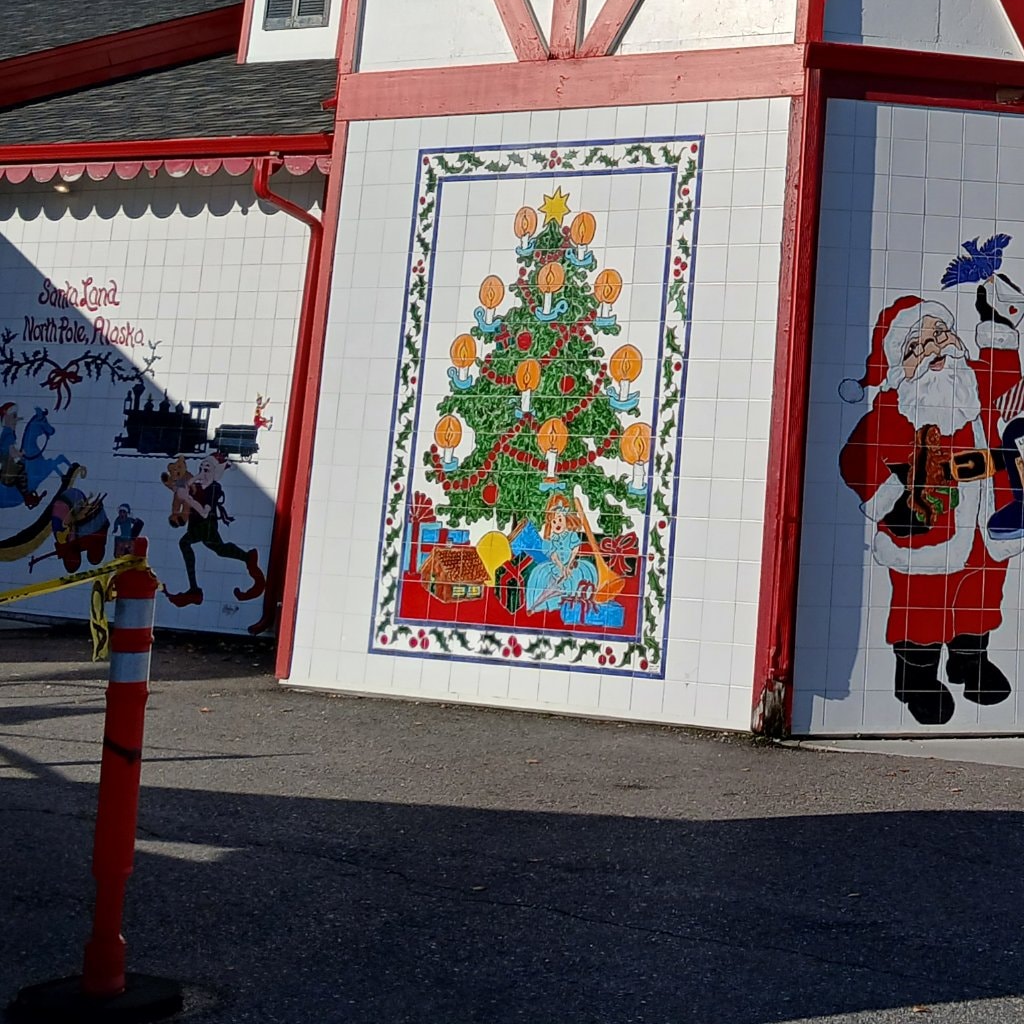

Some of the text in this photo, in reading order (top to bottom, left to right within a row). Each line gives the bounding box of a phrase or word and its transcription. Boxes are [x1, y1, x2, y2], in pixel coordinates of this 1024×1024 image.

[38, 277, 120, 311] Santa Land
[23, 315, 145, 348] North Pole, Alaska
